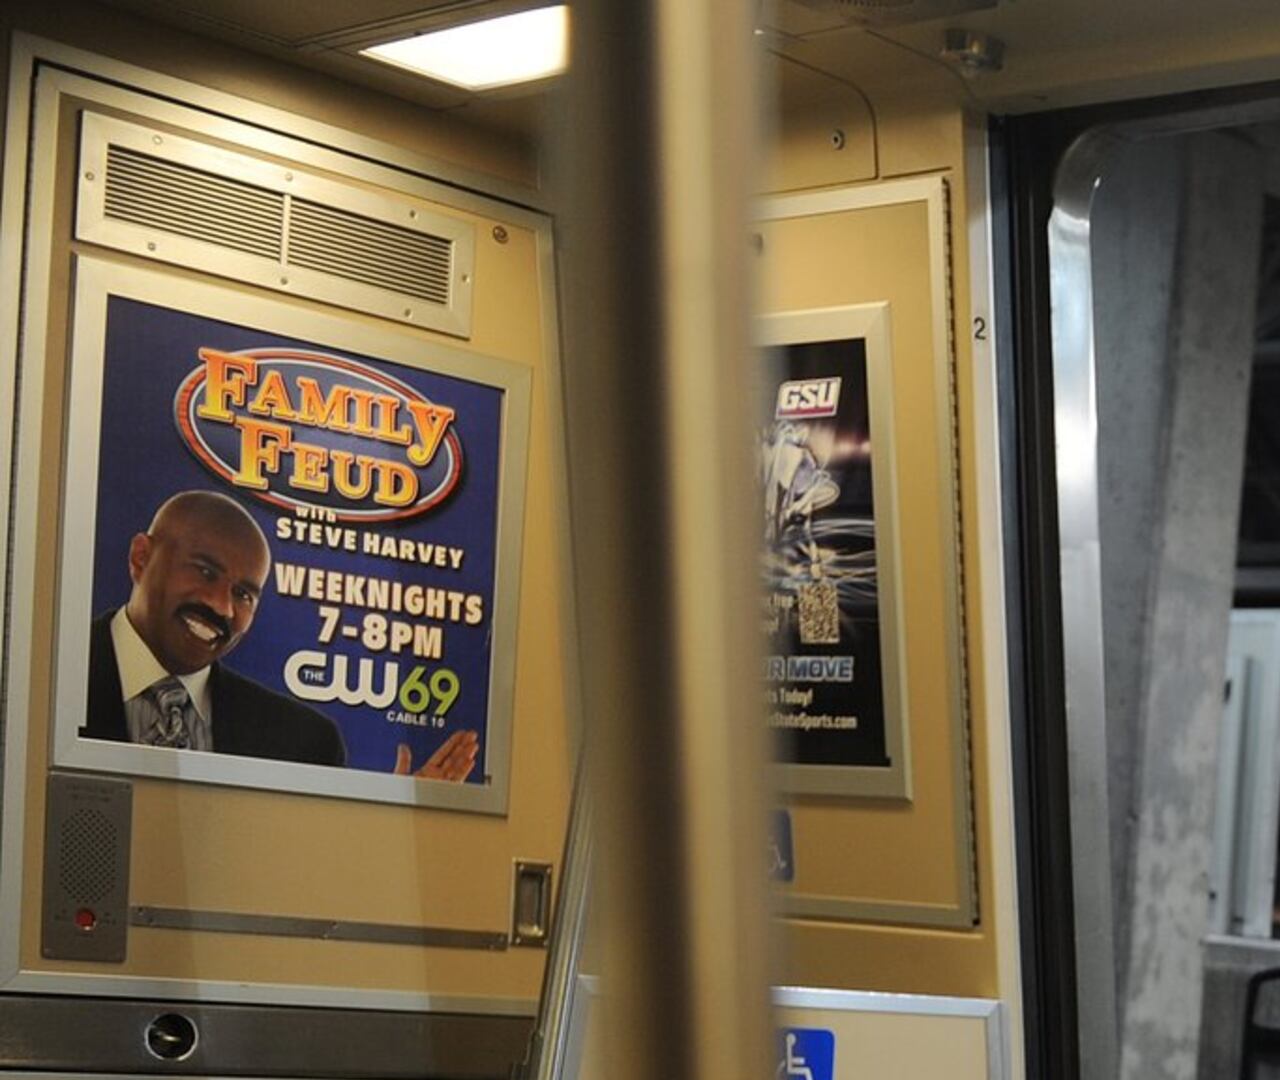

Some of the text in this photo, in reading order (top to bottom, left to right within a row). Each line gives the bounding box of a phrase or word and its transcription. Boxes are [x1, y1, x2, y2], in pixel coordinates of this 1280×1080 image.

[974, 317, 987, 340] 2
[196, 345, 455, 464] FAMILY
[780, 380, 838, 410] GSU
[232, 418, 420, 508] FEUD
[276, 516, 465, 569] STEVE HARVEY
[274, 562, 483, 625] WEEKNIGHTS
[317, 606, 444, 659] 7-8PM
[284, 650, 460, 716] THE CW 69
[788, 656, 854, 681] MOVE
[386, 709, 445, 728] CABLE 10
